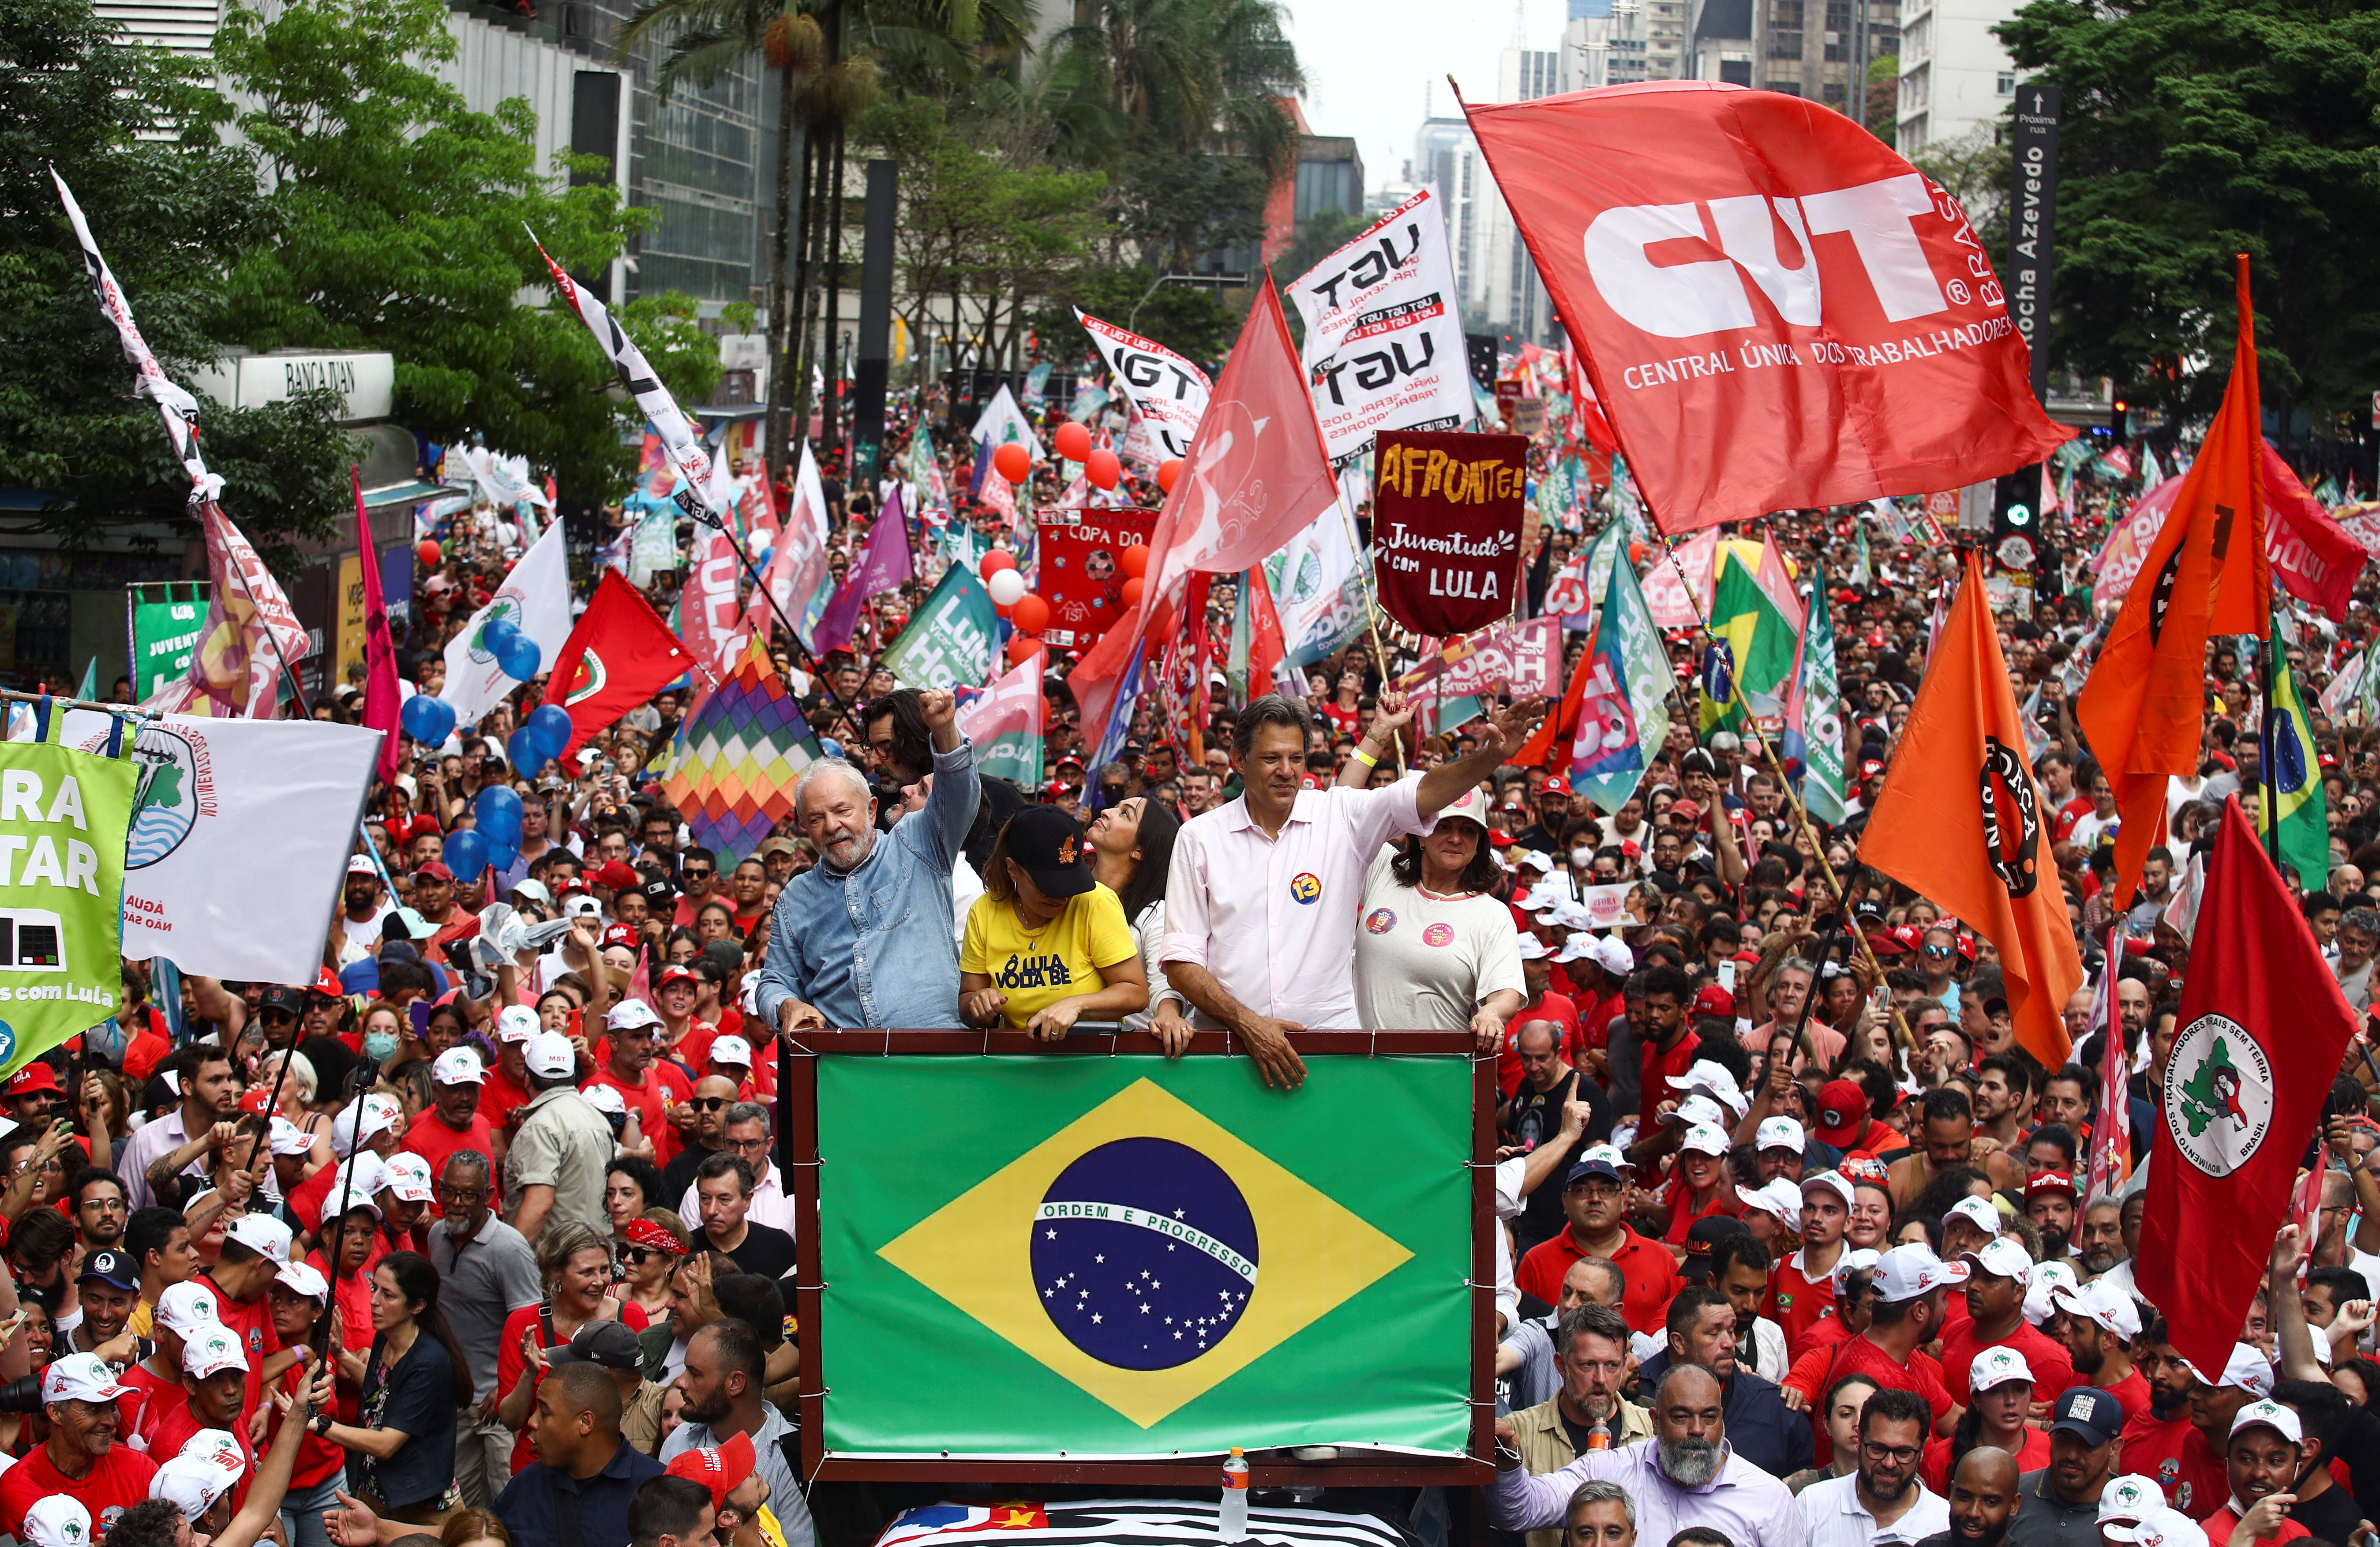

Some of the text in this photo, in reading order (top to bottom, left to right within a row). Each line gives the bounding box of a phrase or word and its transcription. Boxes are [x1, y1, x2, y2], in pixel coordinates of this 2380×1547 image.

[2019, 113, 2056, 125] Próxima
[2030, 126, 2046, 135] rua
[2016, 146, 2044, 260] Azevedo
[1584, 173, 1948, 338] CUT
[1087, 318, 1158, 353] UGT UGT UGT
[1623, 314, 2013, 390] CENTRAL ÚNICA DOS TRABALHADORES
[285, 361, 327, 397] BANCA
[1378, 443, 1524, 505] AFRONTE!
[1068, 525, 1143, 547] COPA DO
[1388, 522, 1500, 557] Juventude
[1392, 555, 1419, 572] COM
[1429, 567, 1499, 601] LULA
[930, 620, 951, 648] Vice:
[1292, 877, 1319, 901] 13
[1294, 874, 1309, 882] VOTE
[995, 967, 1046, 989] VOLTA
[1004, 953, 1064, 976] Ô LULA
[16, 985, 62, 1001] com
[66, 982, 114, 1009] Lula
[2228, 1025, 2249, 1044] SEM
[2166, 1020, 2206, 1108] TRABALHADORES
[2248, 1043, 2269, 1084] TERRA
[14, 1071, 31, 1084] LULA
[2168, 1111, 2181, 1136] DOS
[2239, 1119, 2267, 1157] BRASIL
[2179, 1135, 2221, 1174] MOVIMENTO
[1044, 1205, 1253, 1277] ORDEM E PROGRESSO
[1873, 1268, 1888, 1280] MST
[2069, 1407, 2092, 1418] PALCO
[2073, 1398, 2095, 1408] GRANDE
